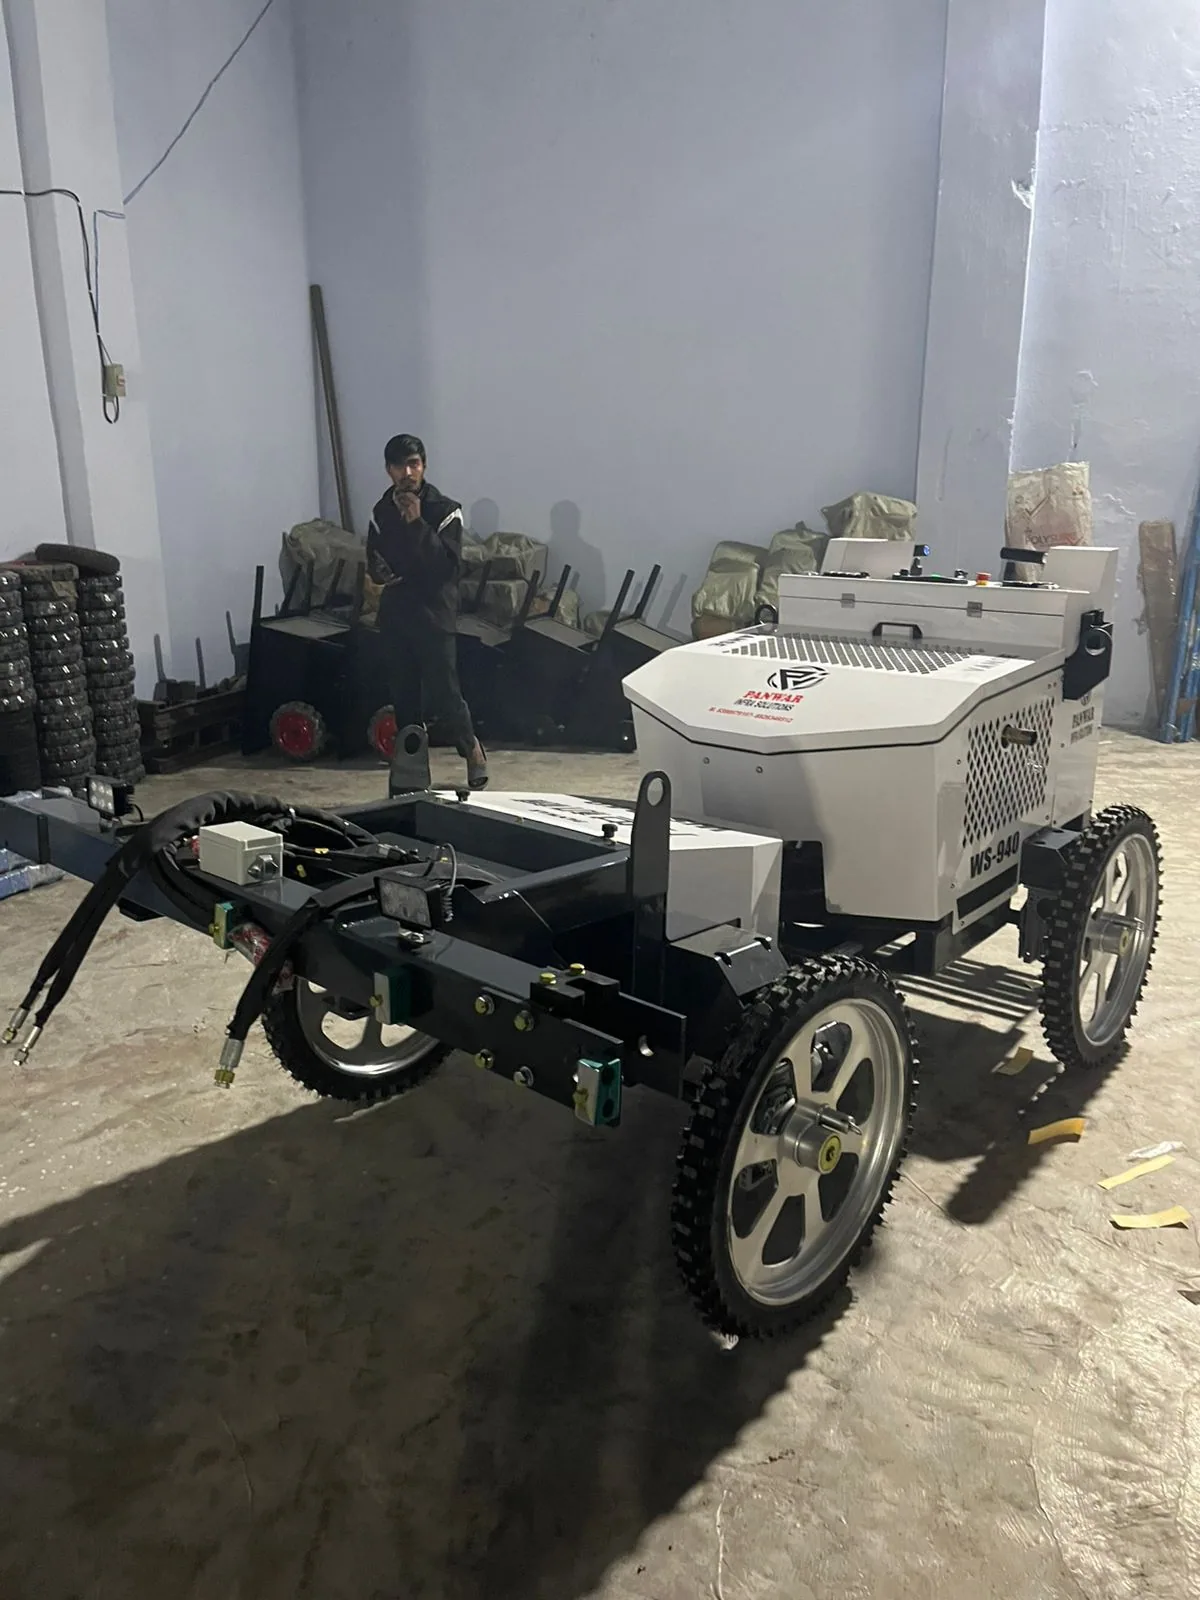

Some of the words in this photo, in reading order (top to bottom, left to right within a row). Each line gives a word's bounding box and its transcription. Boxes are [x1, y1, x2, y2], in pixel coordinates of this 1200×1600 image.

[743, 690, 804, 704] PANWAR
[754, 700, 795, 712] SOLUTIONS
[970, 831, 1020, 879] WS-940
